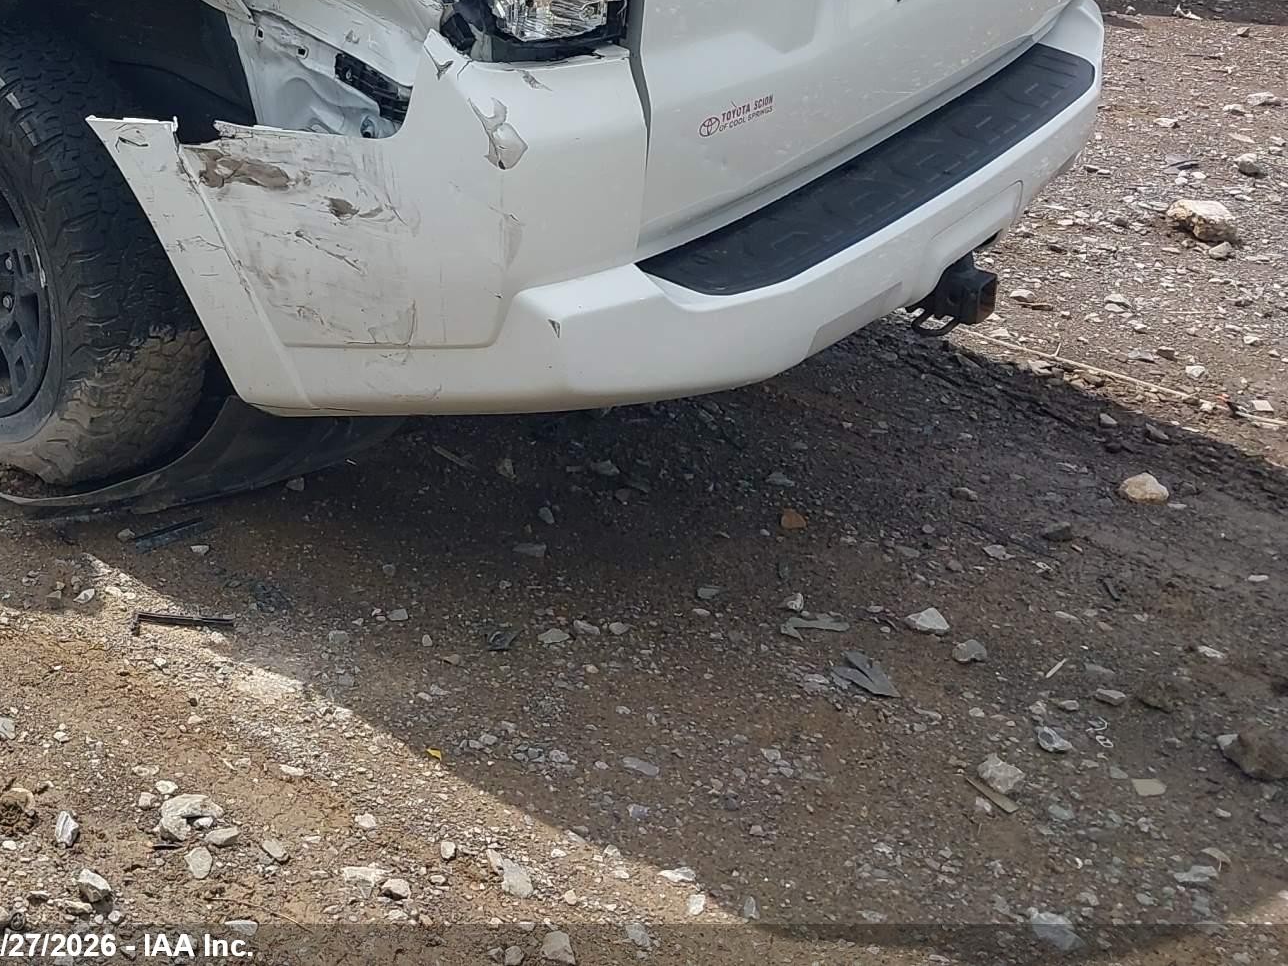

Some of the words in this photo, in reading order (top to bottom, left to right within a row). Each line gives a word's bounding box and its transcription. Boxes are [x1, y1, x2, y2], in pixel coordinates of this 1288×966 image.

[719, 123, 728, 132] OF
[729, 116, 746, 128] COOL
[748, 106, 773, 121] SPRINGS
[721, 103, 751, 123] TOYOTA
[753, 94, 774, 111] SCION
